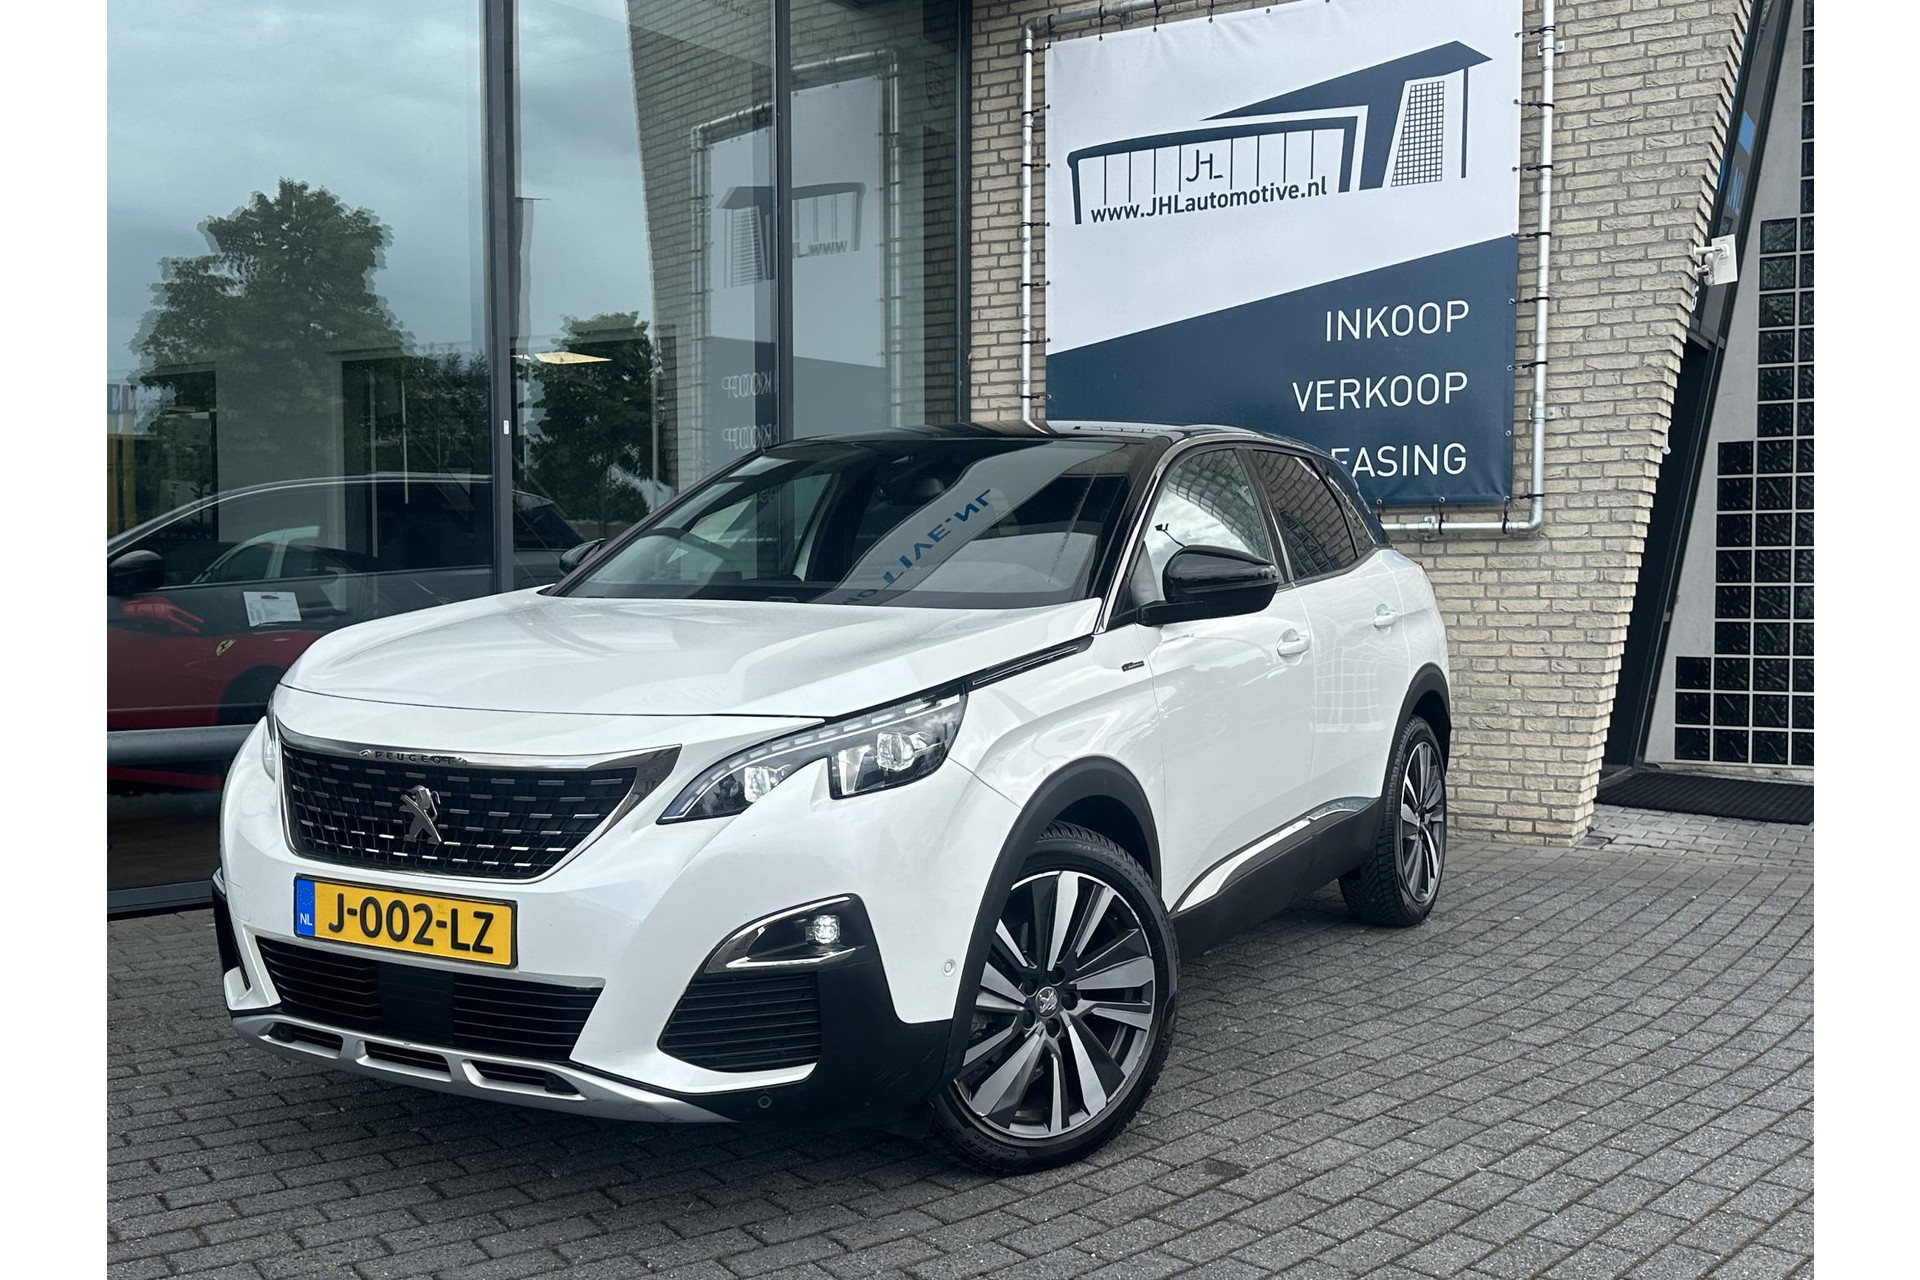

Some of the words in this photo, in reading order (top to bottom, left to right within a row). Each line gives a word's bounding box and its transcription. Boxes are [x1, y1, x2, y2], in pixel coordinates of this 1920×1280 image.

[1091, 176, 1327, 223] www.JHLautomotive.nl
[1326, 299, 1469, 342] INKOOP
[1292, 371, 1468, 412] VERKOOP
[1331, 442, 1467, 478] ASING
[374, 750, 456, 766] PEUGEOT
[300, 912, 313, 927] NL
[328, 892, 494, 955] J-002-LZ
